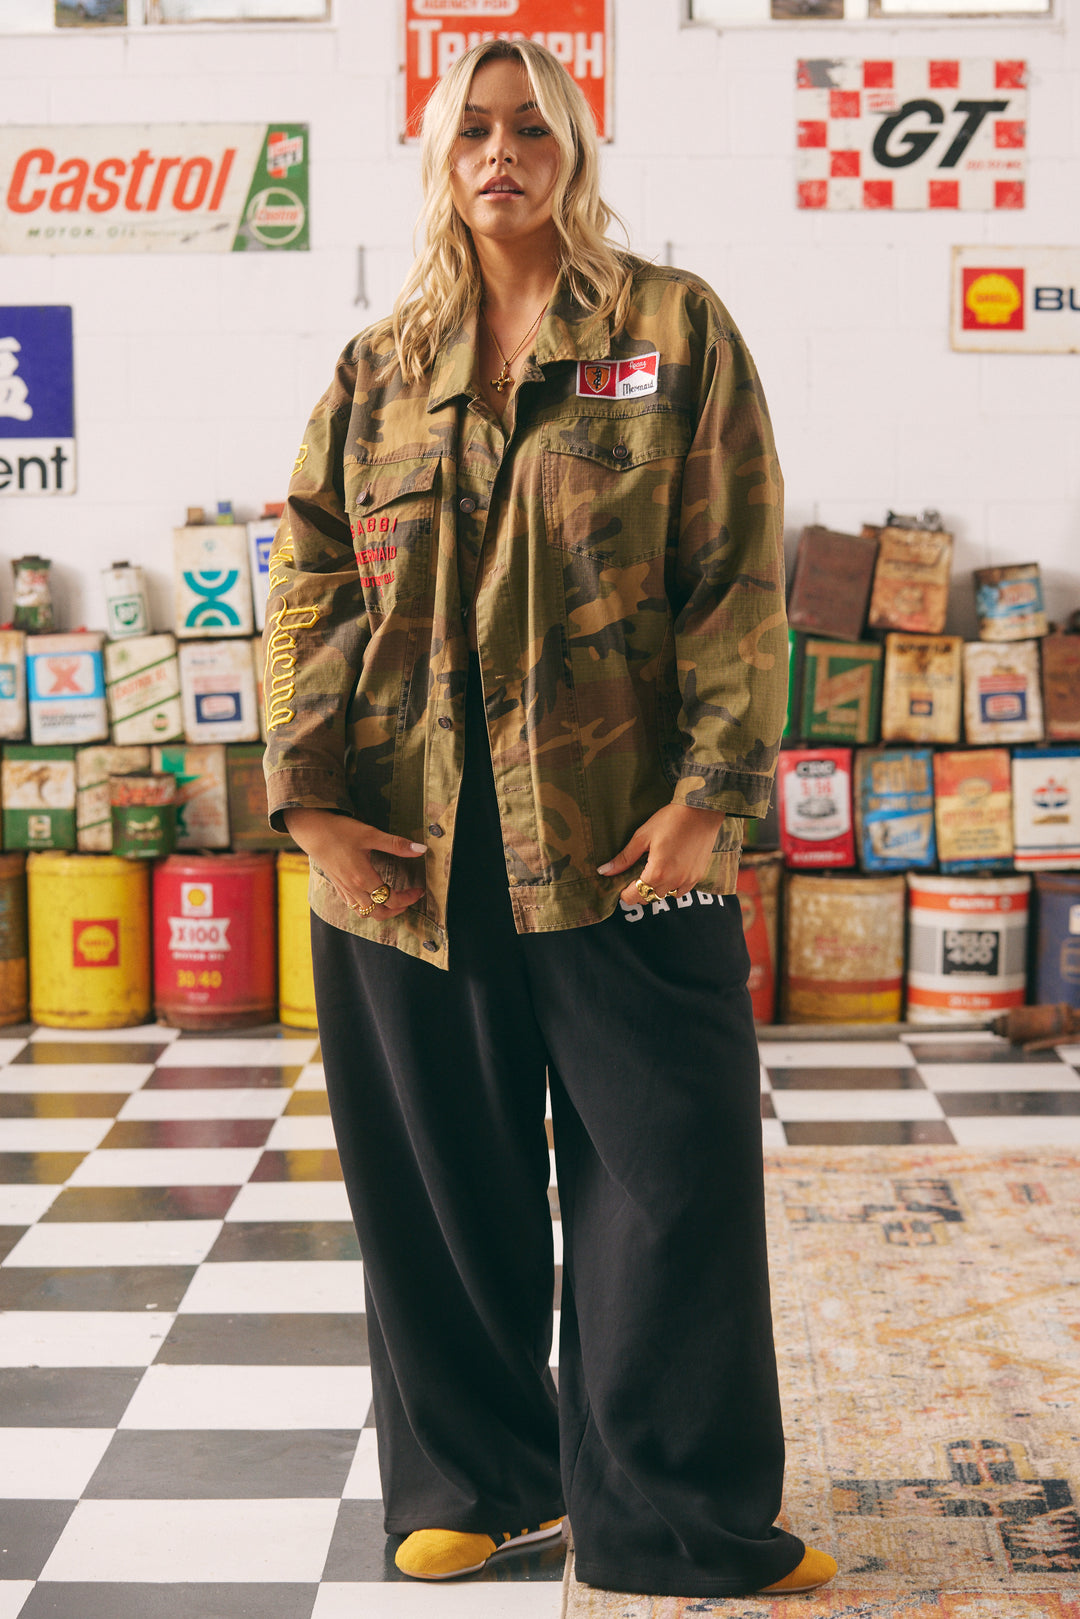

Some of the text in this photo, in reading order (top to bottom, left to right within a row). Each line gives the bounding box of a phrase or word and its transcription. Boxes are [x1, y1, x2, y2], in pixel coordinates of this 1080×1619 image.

[872, 98, 1010, 169] GT
[6, 147, 237, 213] Castrol
[27, 226, 96, 238] MOTOR
[944, 930, 998, 949] DELO
[947, 947, 994, 966] 400
